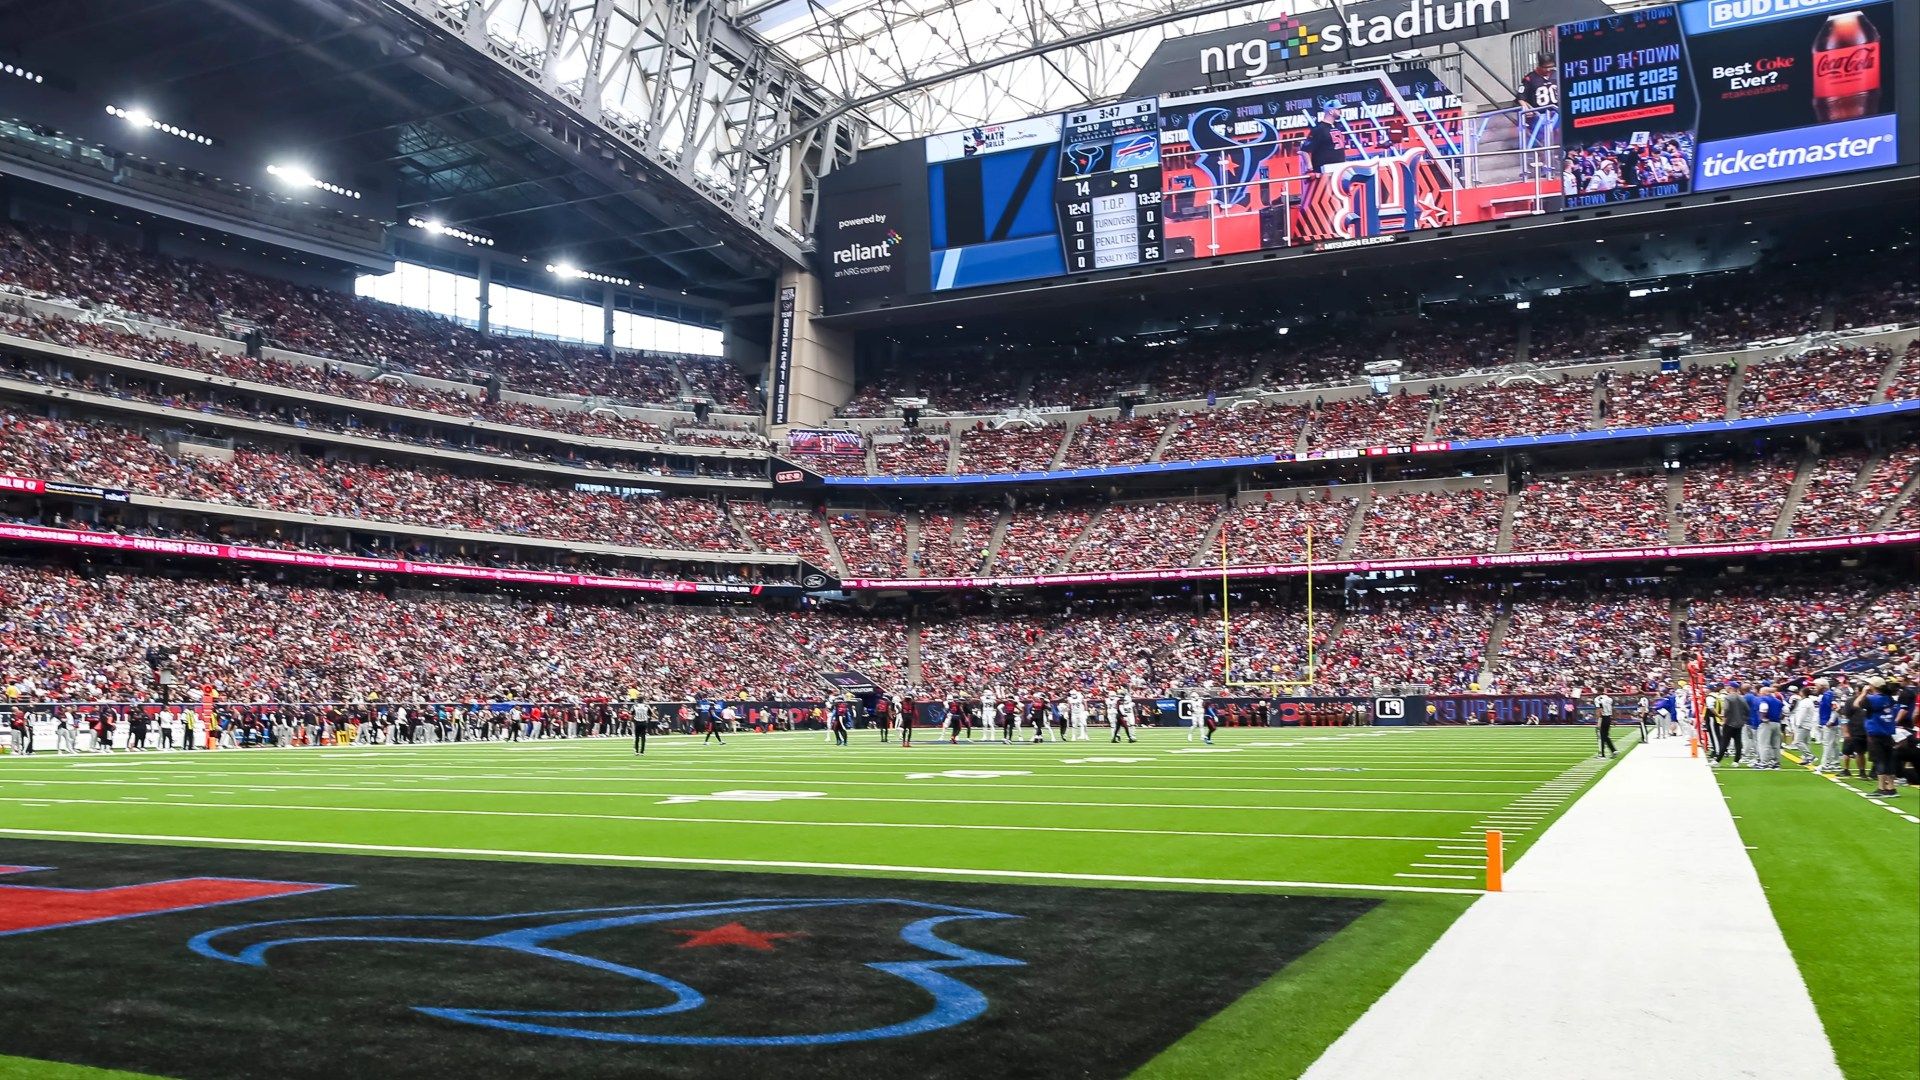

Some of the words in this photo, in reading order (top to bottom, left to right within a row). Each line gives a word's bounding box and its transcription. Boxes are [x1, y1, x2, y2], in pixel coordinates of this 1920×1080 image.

[1714, 0, 1771, 22] BUD
[1200, 38, 1269, 76] nrg
[1320, 0, 1511, 53] stadium
[1564, 60, 1588, 78] H'S
[1593, 55, 1612, 73] UP
[1712, 62, 1752, 79] Best
[1756, 56, 1795, 72] Coke
[1568, 79, 1603, 97] JOIN
[1606, 73, 1635, 91] THE
[1638, 66, 1678, 86] 2025
[1731, 72, 1779, 90] Ever?
[1571, 90, 1639, 114] PRIORITY
[1643, 84, 1676, 103] LIST
[1099, 107, 1120, 119] 3:47
[1075, 181, 1090, 197] 14
[1129, 174, 1138, 188] 3
[1068, 202, 1090, 216] 12:41
[1101, 197, 1126, 210] T.O.P.
[1138, 191, 1162, 205] 13:32
[838, 214, 875, 230] powered
[875, 214, 886, 224] by
[1076, 221, 1084, 232] 0
[1095, 215, 1136, 228] TURNOVERS
[1146, 211, 1154, 222] 0
[1077, 239, 1085, 250] 0
[1096, 233, 1136, 247] PENALTIES
[1147, 229, 1155, 240] 4
[1324, 239, 1361, 250] MITSUBISHI
[1361, 235, 1395, 246] ELECTRIC
[833, 240, 892, 264] reliant
[1078, 257, 1086, 268] 0
[1096, 253, 1124, 265] PENALTY
[1145, 247, 1159, 259] 25
[843, 267, 860, 276] NRG
[860, 264, 891, 274] company
[186, 543, 219, 556] DEALS
[1490, 556, 1510, 564] FAN
[1510, 554, 1537, 563] FIRST
[1537, 552, 1569, 562] DEALS
[1010, 576, 1036, 585] DEALS
[1385, 700, 1401, 715] 19
